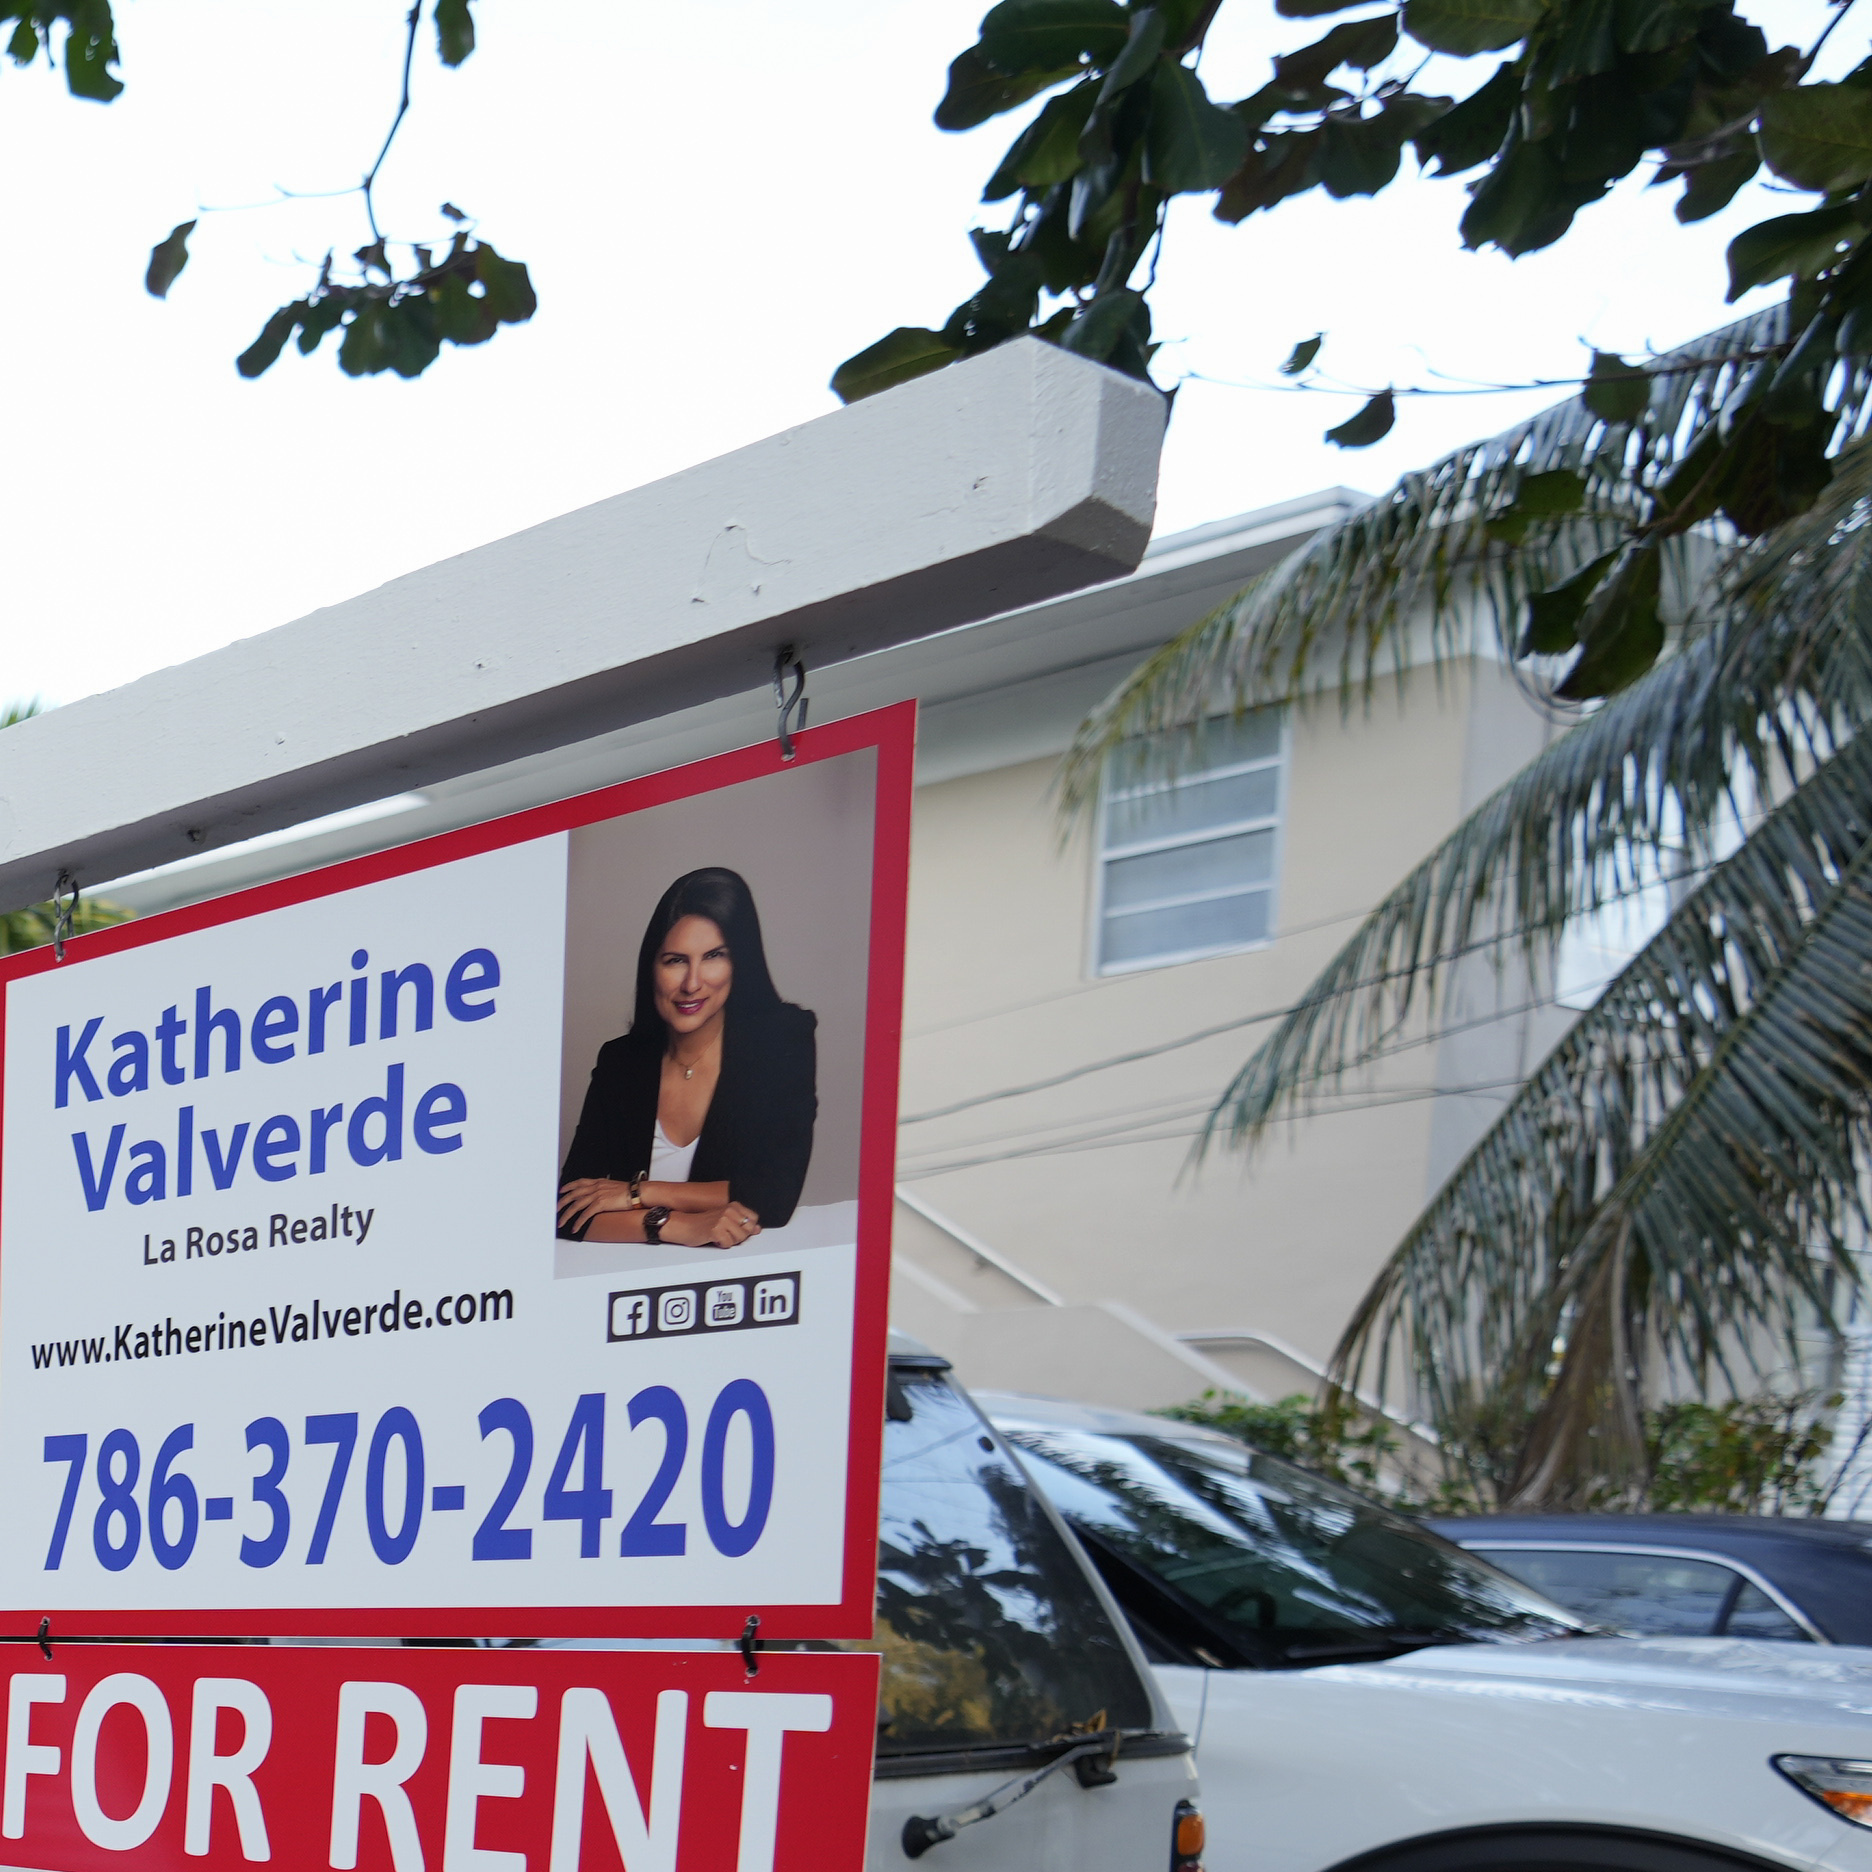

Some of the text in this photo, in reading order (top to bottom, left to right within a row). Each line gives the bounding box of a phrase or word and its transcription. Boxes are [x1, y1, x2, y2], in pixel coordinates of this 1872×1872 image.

[54, 948, 501, 1110] Katherine
[70, 1062, 468, 1213] Valverde
[143, 1202, 375, 1266] La Rosa Realty
[30, 1288, 514, 1370] www.KatherineValverde.com
[42, 1378, 776, 1572] 786-370-2420
[1, 1672, 273, 1863] FOR
